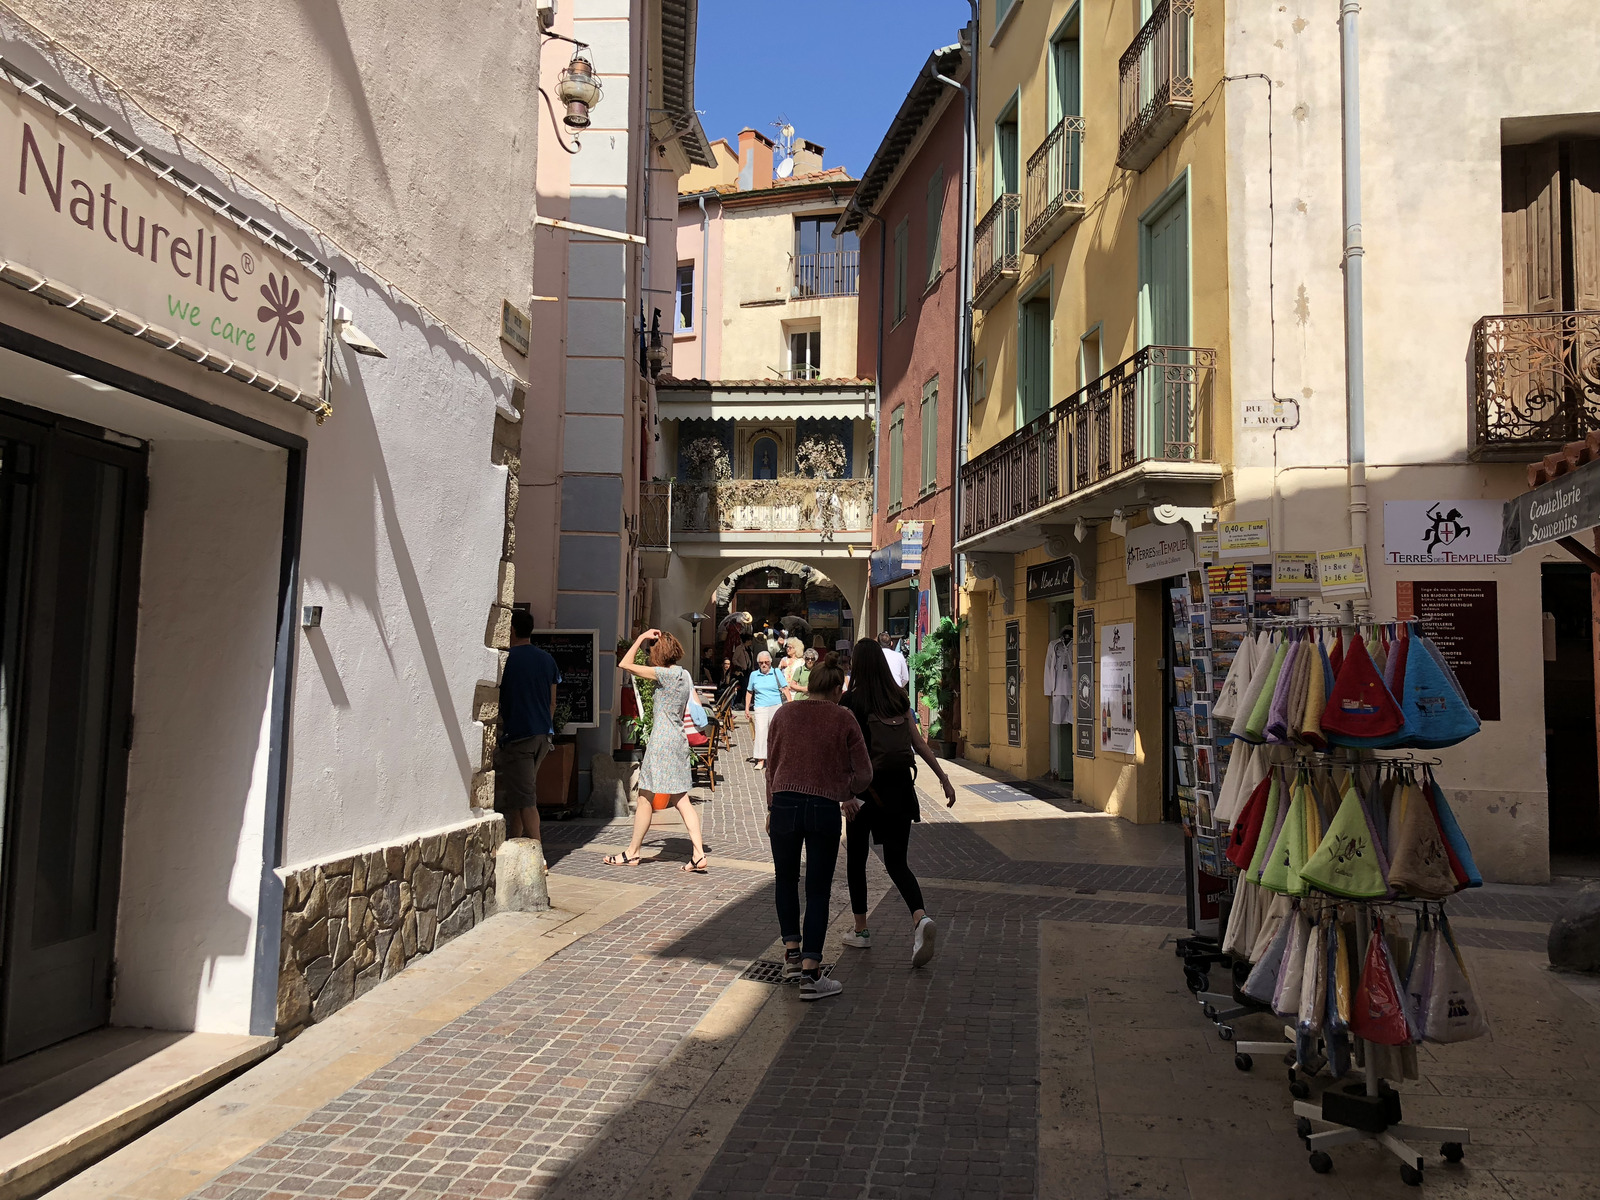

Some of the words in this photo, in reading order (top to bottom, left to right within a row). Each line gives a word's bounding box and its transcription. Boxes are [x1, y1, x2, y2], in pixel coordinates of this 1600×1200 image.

[168, 294, 200, 327] we
[210, 314, 257, 352] care
[1256, 416, 1289, 424] ARAGO
[1529, 485, 1581, 520] Coutellerie
[1528, 513, 1578, 543] Souvenirs
[1135, 546, 1156, 561] TERRES
[1389, 551, 1433, 563] TERRES
